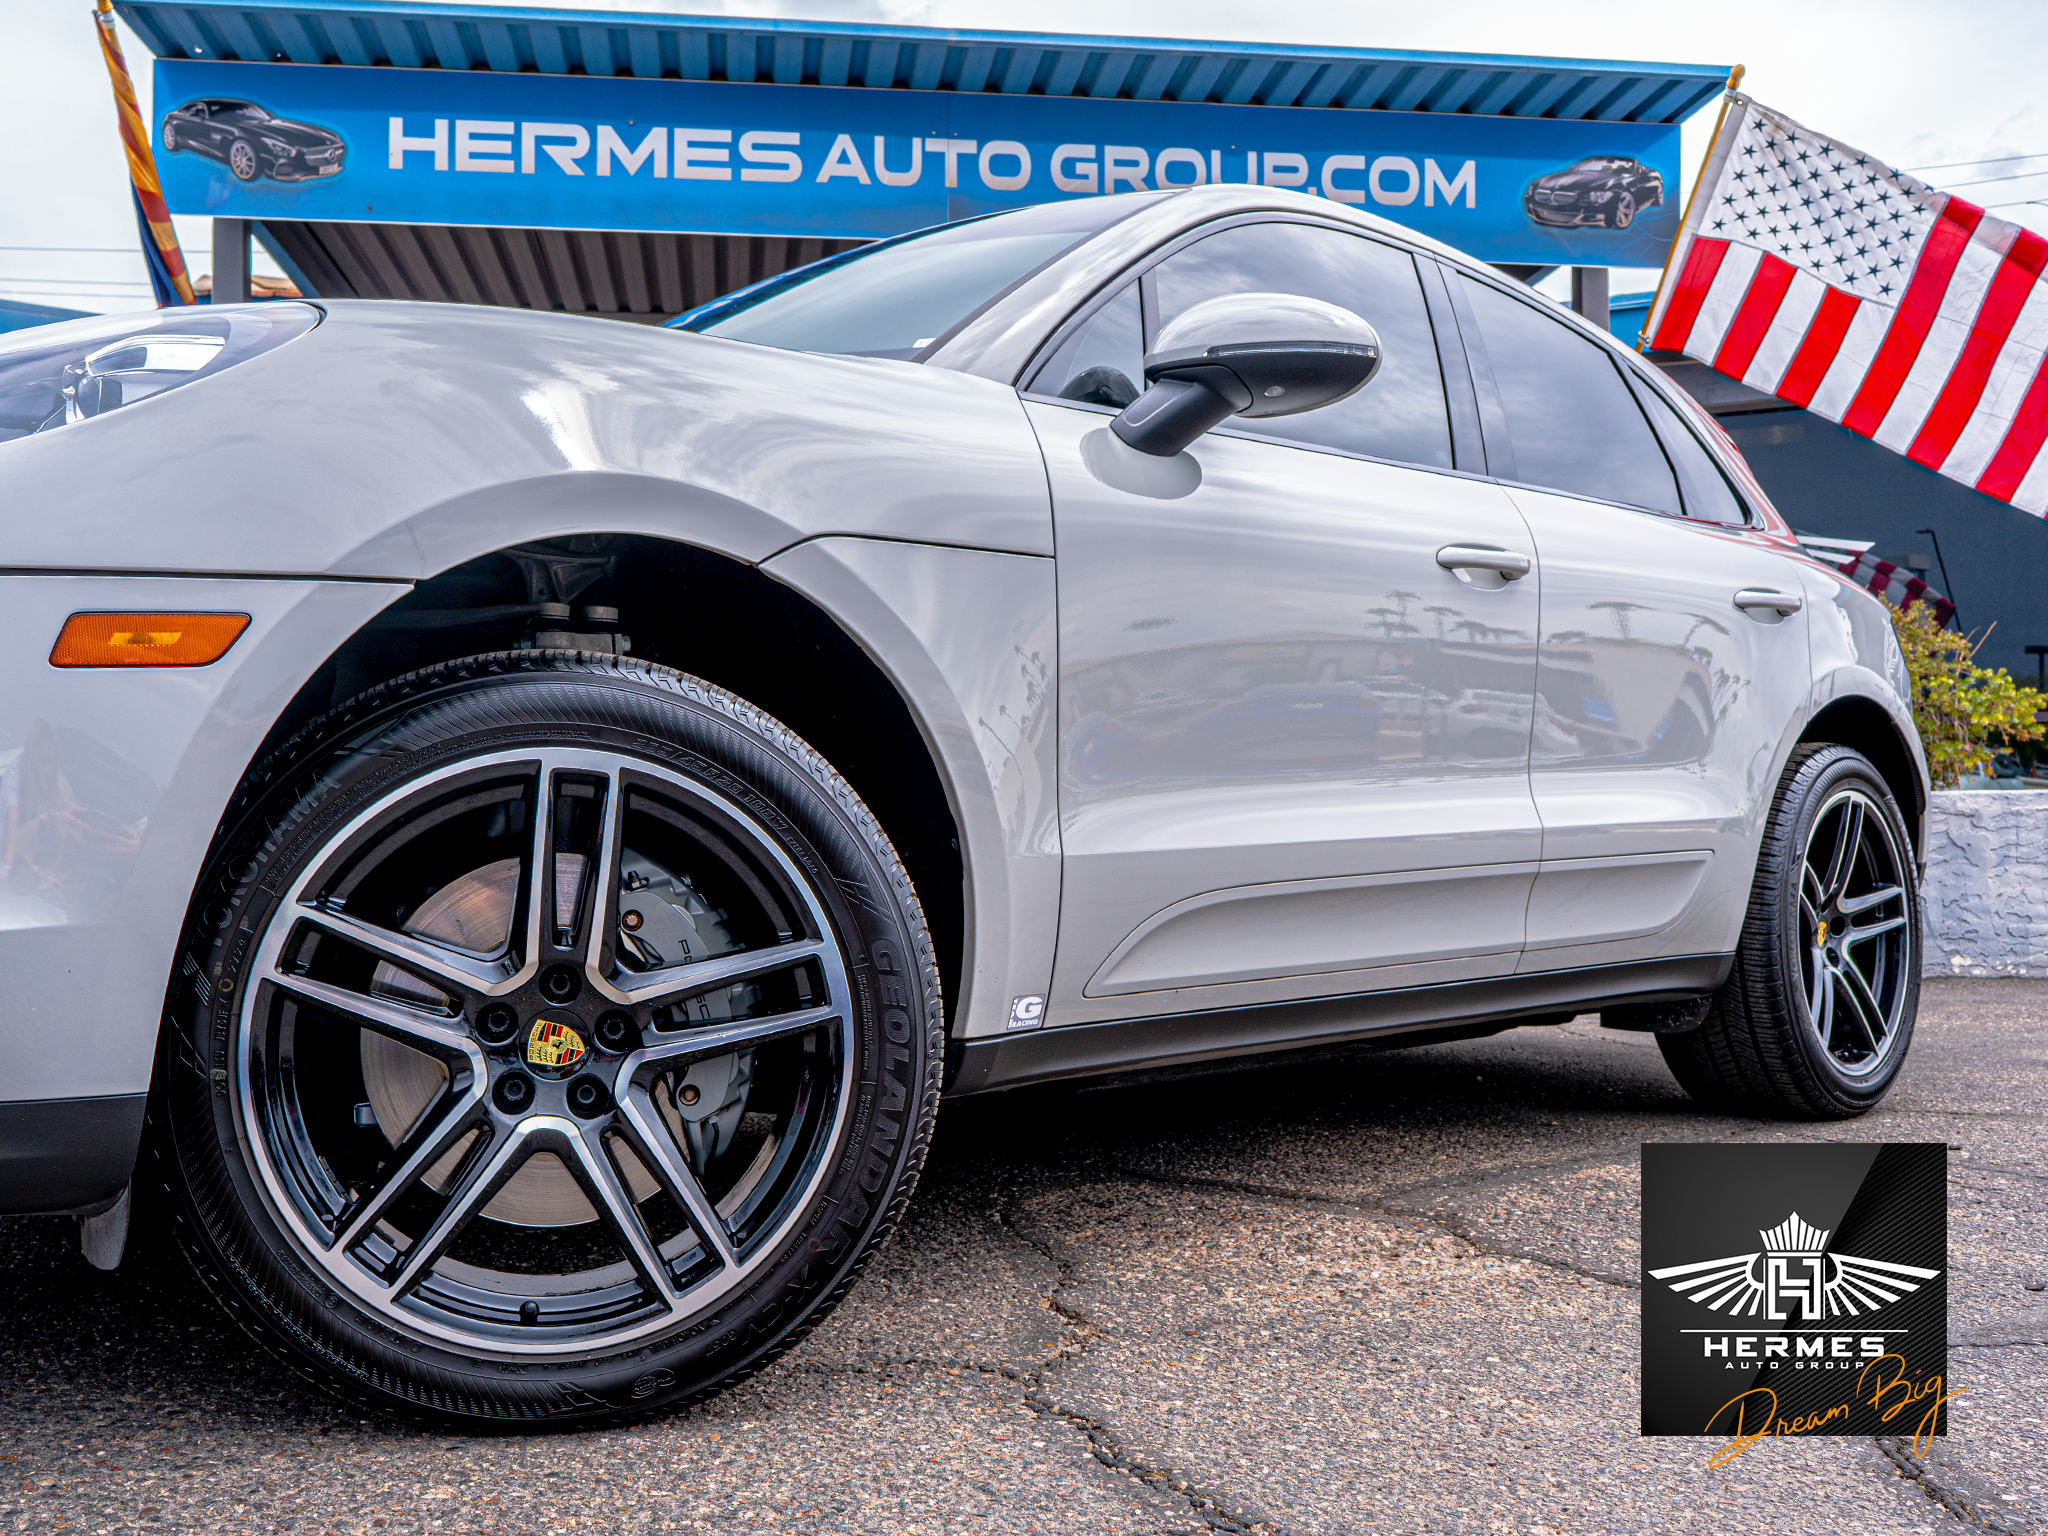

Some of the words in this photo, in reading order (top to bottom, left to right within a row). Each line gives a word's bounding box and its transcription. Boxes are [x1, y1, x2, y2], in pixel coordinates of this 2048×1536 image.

[388, 116, 803, 183] HERMES
[816, 133, 1032, 192] AUTO
[1050, 143, 1476, 209] GROUP.COM
[191, 769, 343, 948] YOKOHAMA
[1012, 1019, 1038, 1028] RACING
[815, 934, 907, 1263] GEOLANDAR
